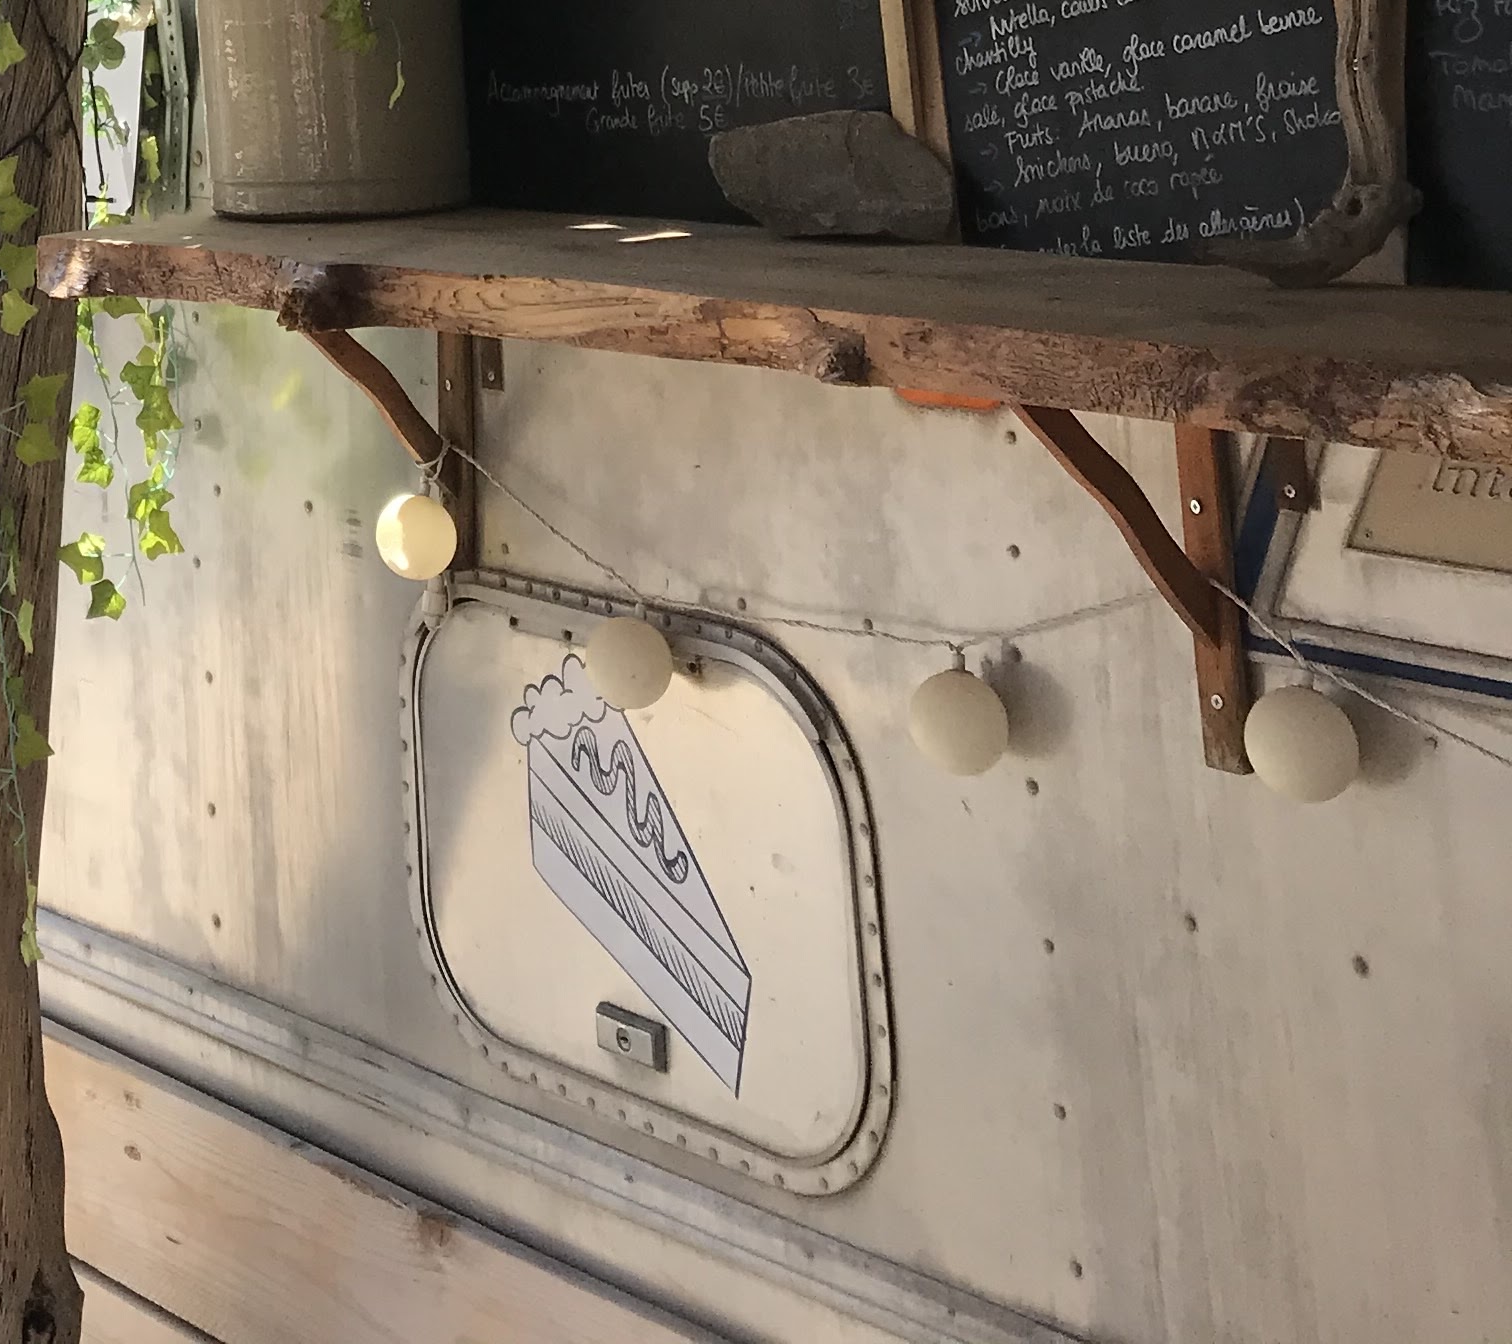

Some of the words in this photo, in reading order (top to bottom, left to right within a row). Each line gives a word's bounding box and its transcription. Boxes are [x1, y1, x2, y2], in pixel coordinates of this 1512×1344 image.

[954, 33, 1038, 76] chantilly
[994, 64, 1041, 97] Glace
[1122, 32, 1166, 79] glace
[1172, 14, 1254, 55] caramel
[1257, 6, 1324, 37] beurre
[1013, 91, 1059, 129] glace
[1254, 70, 1321, 113] fraise
[1089, 176, 1115, 208] de
[1112, 222, 1152, 251] liste
